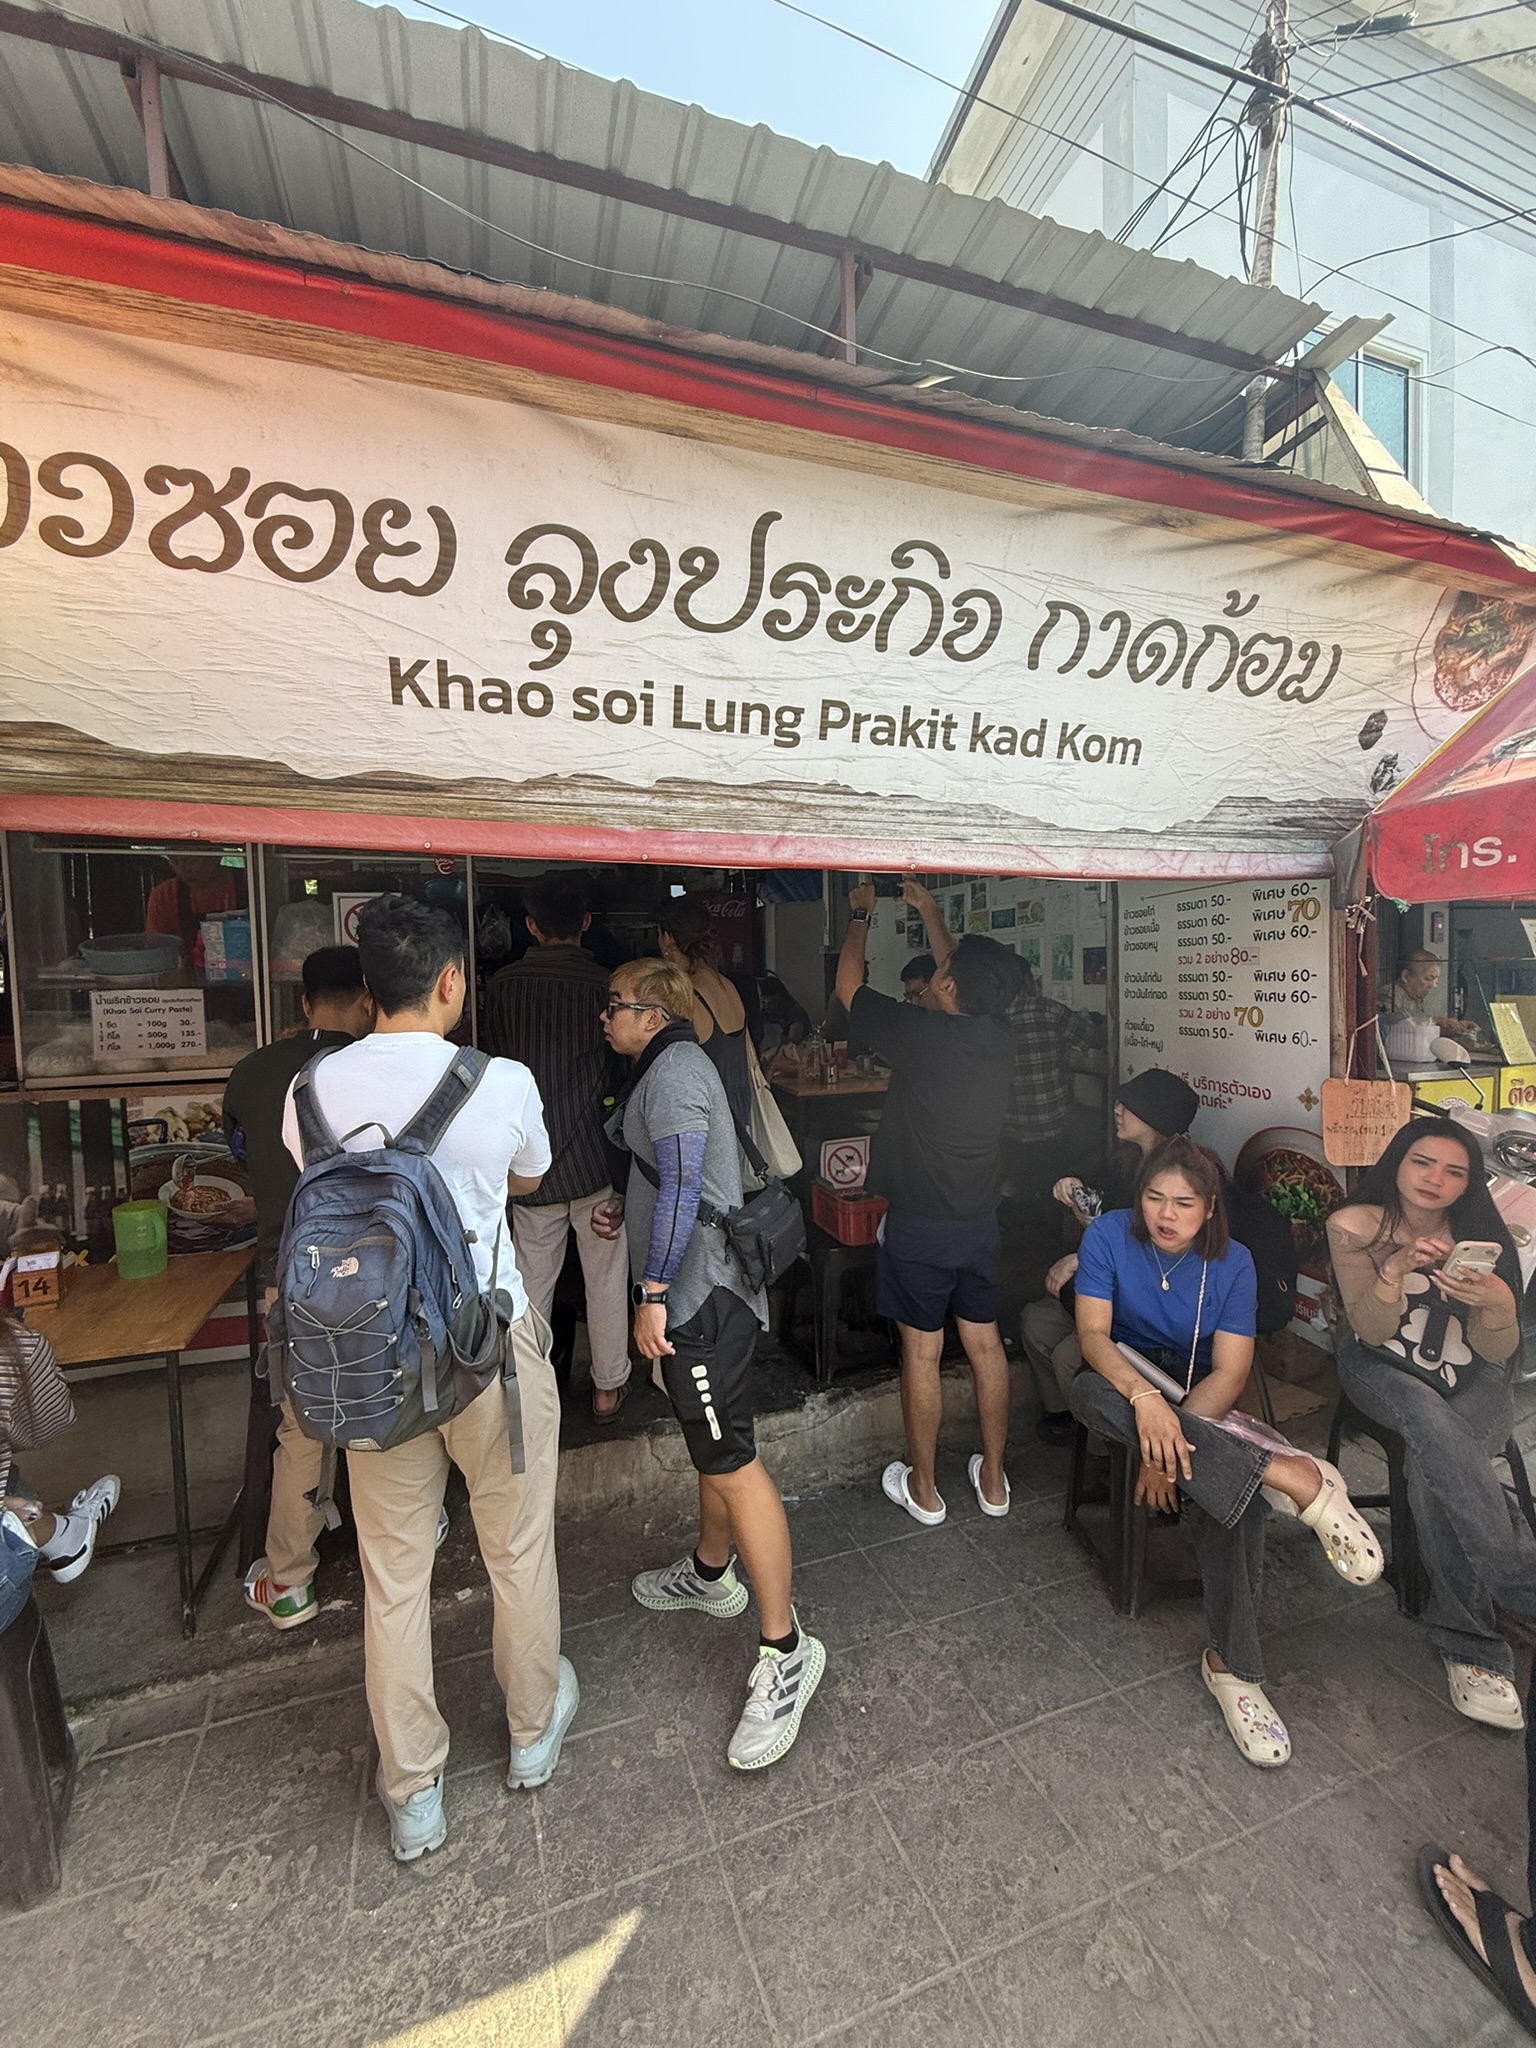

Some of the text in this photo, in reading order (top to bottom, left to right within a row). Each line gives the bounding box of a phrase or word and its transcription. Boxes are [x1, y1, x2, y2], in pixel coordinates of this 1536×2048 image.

[504, 510, 1003, 671] ลุงประกิจ
[1026, 589, 1343, 705] กาดก้อม
[388, 656, 1143, 766] Khao soi Lung Prakit kad Kom
[702, 899, 748, 918] ca-Cola
[1123, 904, 1156, 920] ข้าวซอยไก่
[1176, 898, 1208, 912] ธรรมดา
[1211, 894, 1232, 907] 50.-
[1252, 888, 1286, 902] พิเศษ
[1177, 917, 1208, 930] ธรรมดา
[1252, 909, 1286, 922] พิเศษ
[1287, 897, 1321, 923] 70
[1123, 924, 1318, 953] ข้าวซอยหมู ธรรมดา 50.- พิเศษ 60.-
[1178, 947, 1258, 965] รวม 2 อย่าง 80.-
[1178, 973, 1209, 983] ธรรมดา
[1212, 970, 1233, 983] 50.-
[1253, 969, 1287, 982] พิเศษ
[1178, 991, 1209, 1001] ธรรมดา
[1212, 989, 1234, 1002] 50.-
[1253, 989, 1287, 1003] พิเศษ
[103, 1007, 127, 1016] (Khao
[144, 1006, 167, 1014] Curry
[168, 1005, 193, 1013] Paste)
[1178, 1005, 1264, 1028] รวม 2 อย่าง 70
[147, 1020, 167, 1029] 100g
[179, 1018, 196, 1026] 30.-
[147, 1031, 168, 1040] 500g
[180, 1030, 202, 1038] 135.-
[148, 1042, 176, 1050] 1,000g
[1178, 1026, 1210, 1038] ธรรมดา
[1212, 1027, 1235, 1040] 50.-
[1254, 1029, 1287, 1044] พิเศษ
[1291, 1029, 1319, 1048] 60.-
[1193, 1075, 1272, 1100] บริการตัวเอง
[17, 1276, 51, 1298] 14
